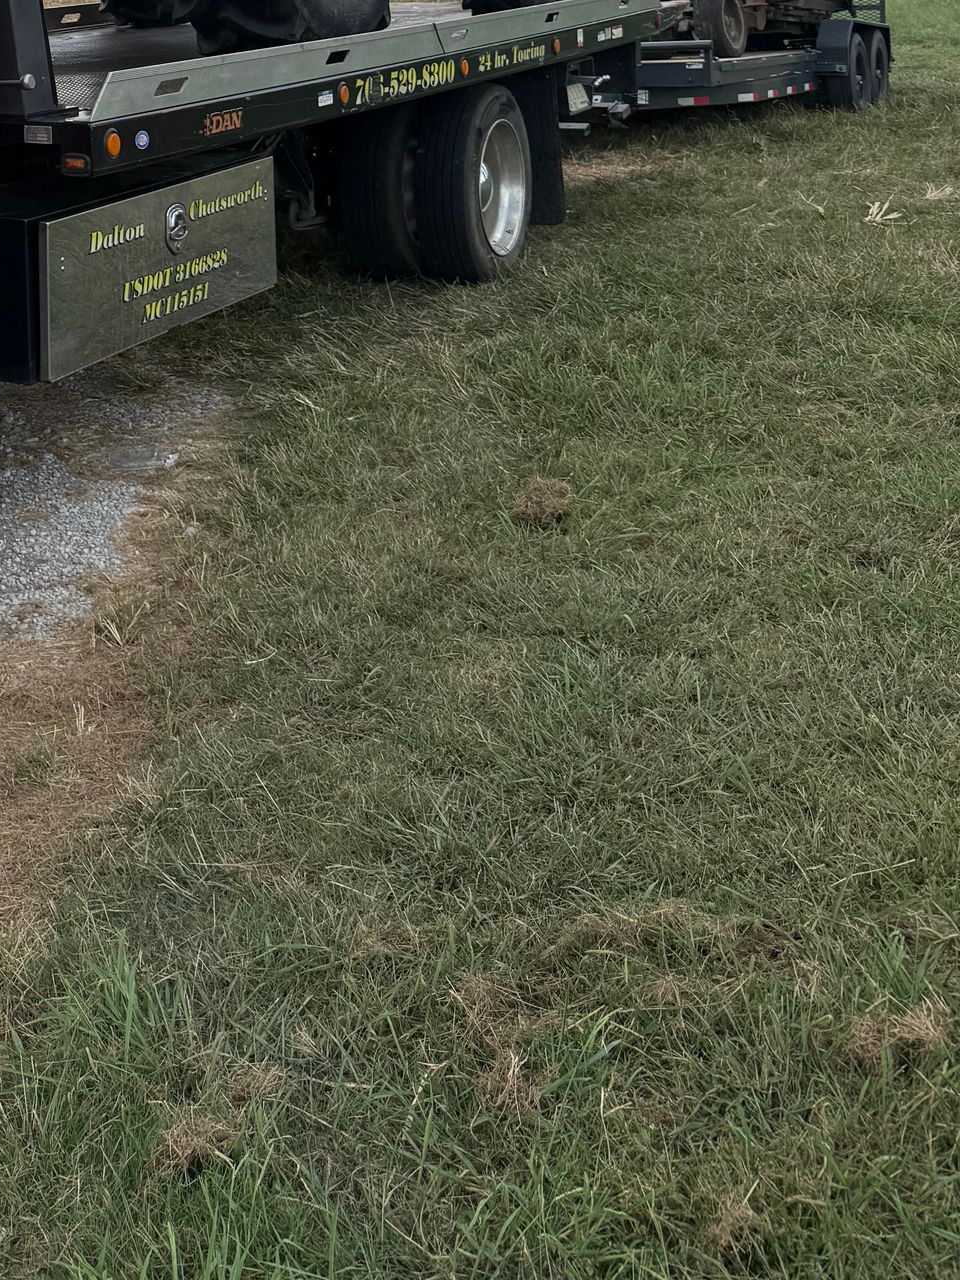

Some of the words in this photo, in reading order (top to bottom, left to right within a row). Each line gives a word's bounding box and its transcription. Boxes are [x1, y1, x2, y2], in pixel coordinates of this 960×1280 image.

[478, 51, 491, 72] 24
[494, 49, 510, 69] hr.
[512, 40, 546, 65] Towing
[89, 223, 145, 254] Dalton
[189, 180, 263, 221] Chatsworth
[123, 266, 174, 302] USDOT
[175, 248, 228, 283] 3166828
[142, 281, 209, 325] MC115151
